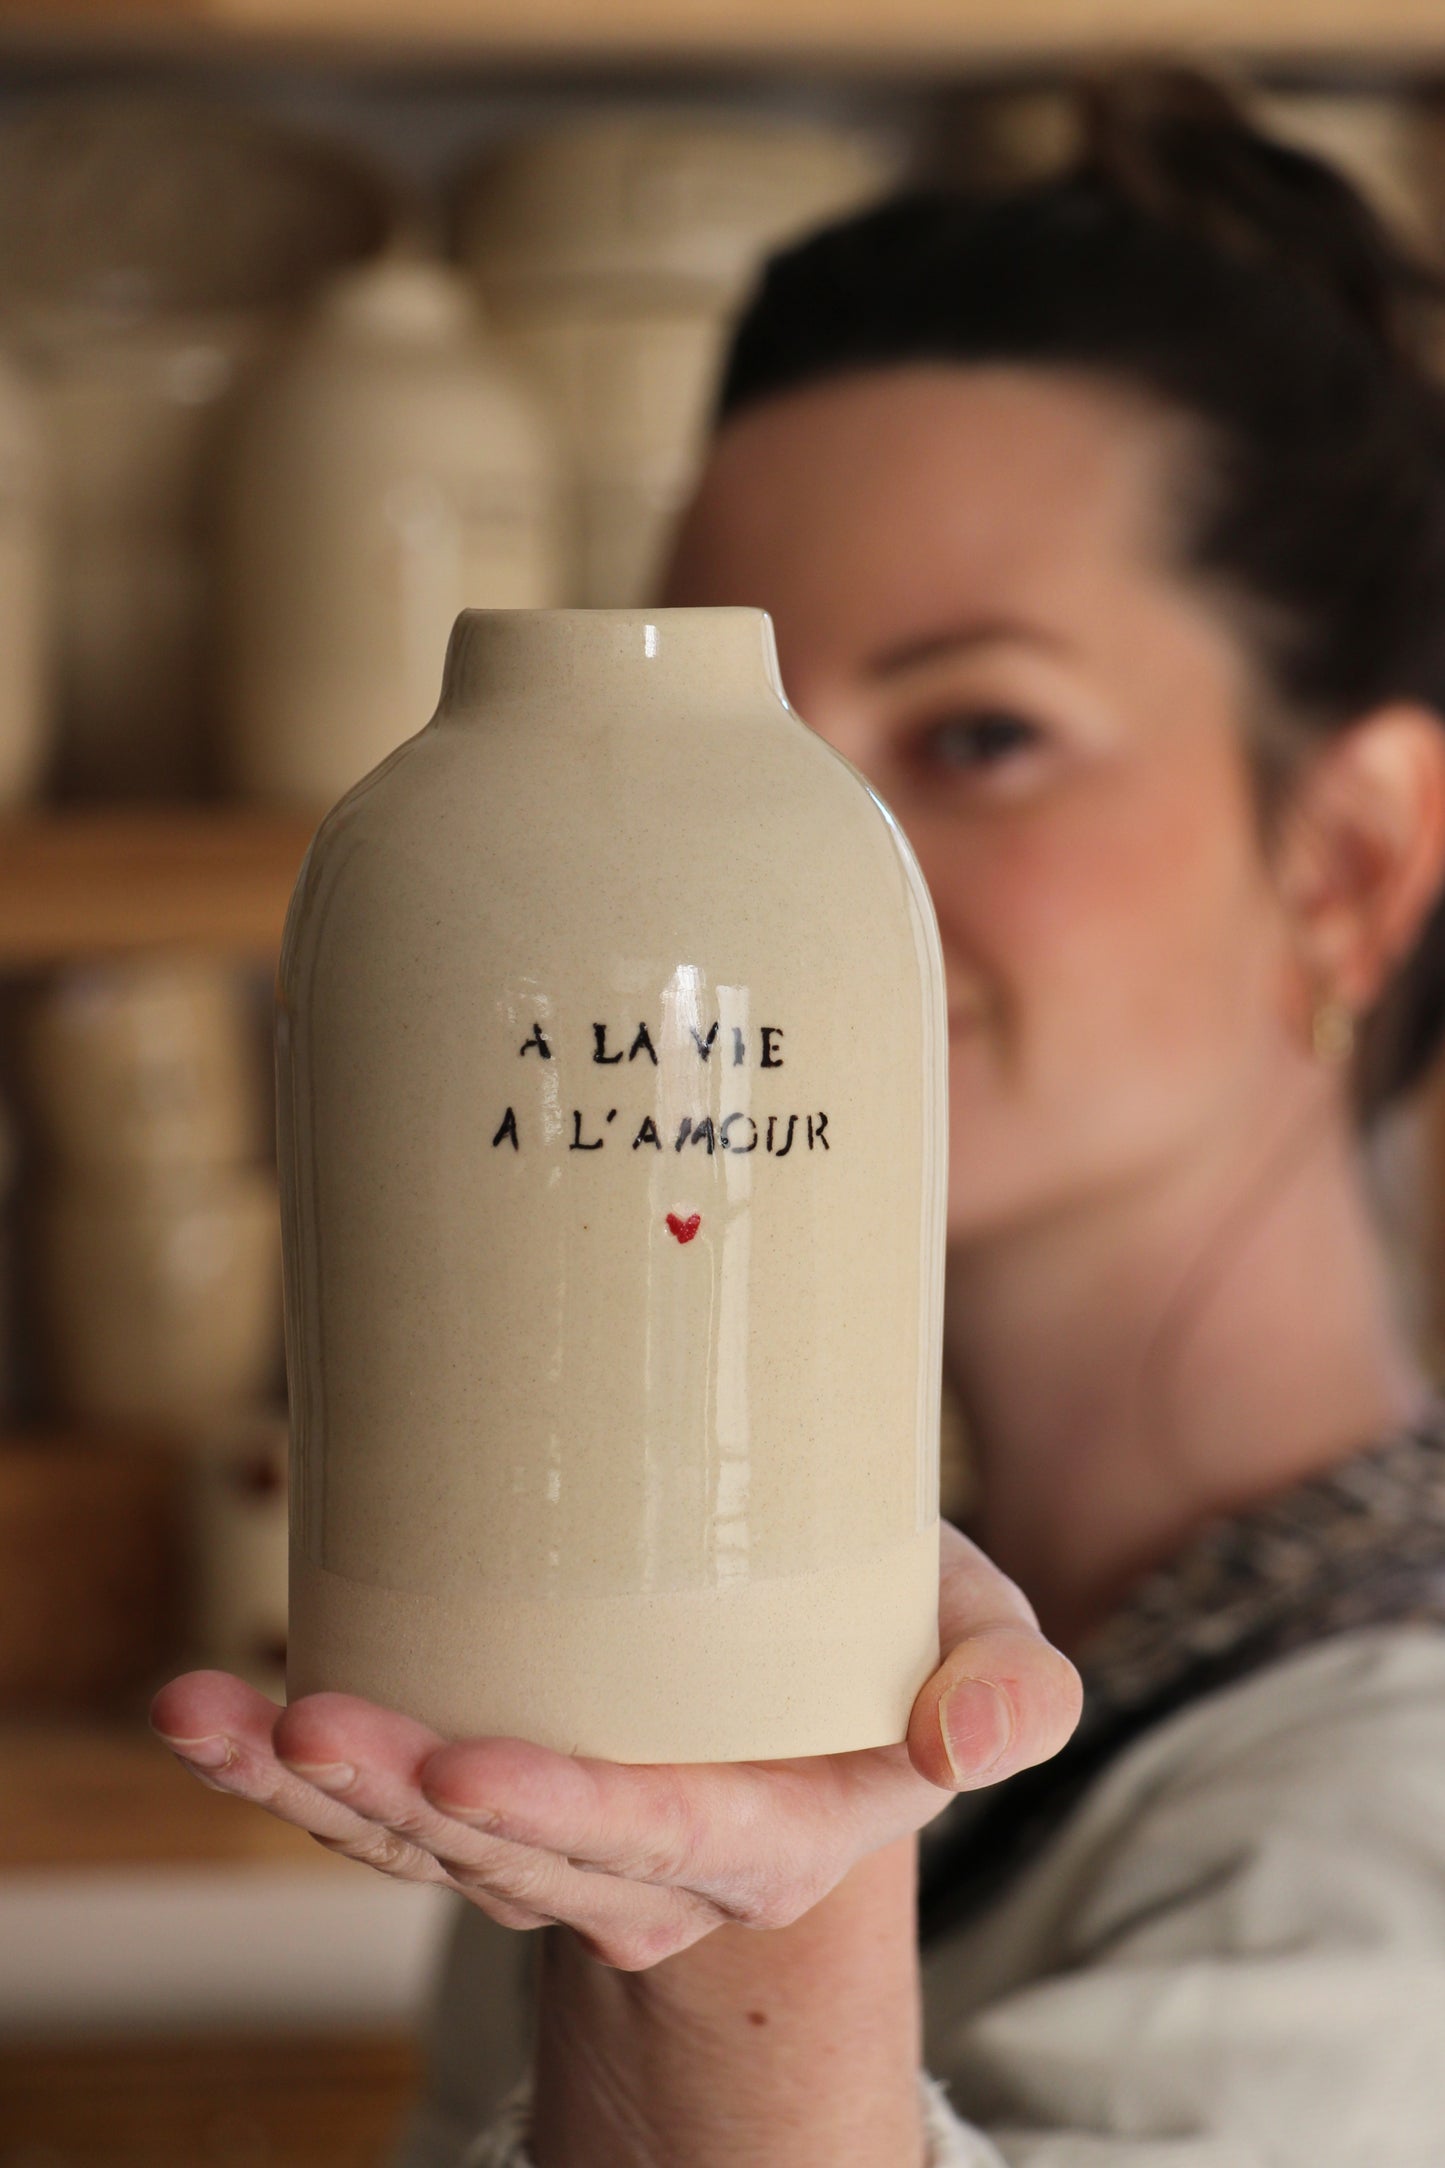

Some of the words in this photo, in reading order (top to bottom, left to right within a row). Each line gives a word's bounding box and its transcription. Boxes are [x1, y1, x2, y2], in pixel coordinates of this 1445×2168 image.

[520, 1022, 551, 1059] A
[593, 1022, 658, 1065] LA
[690, 1021, 784, 1067] VIE
[492, 1107, 519, 1151] A
[569, 1109, 830, 1157] L'AMOUR
